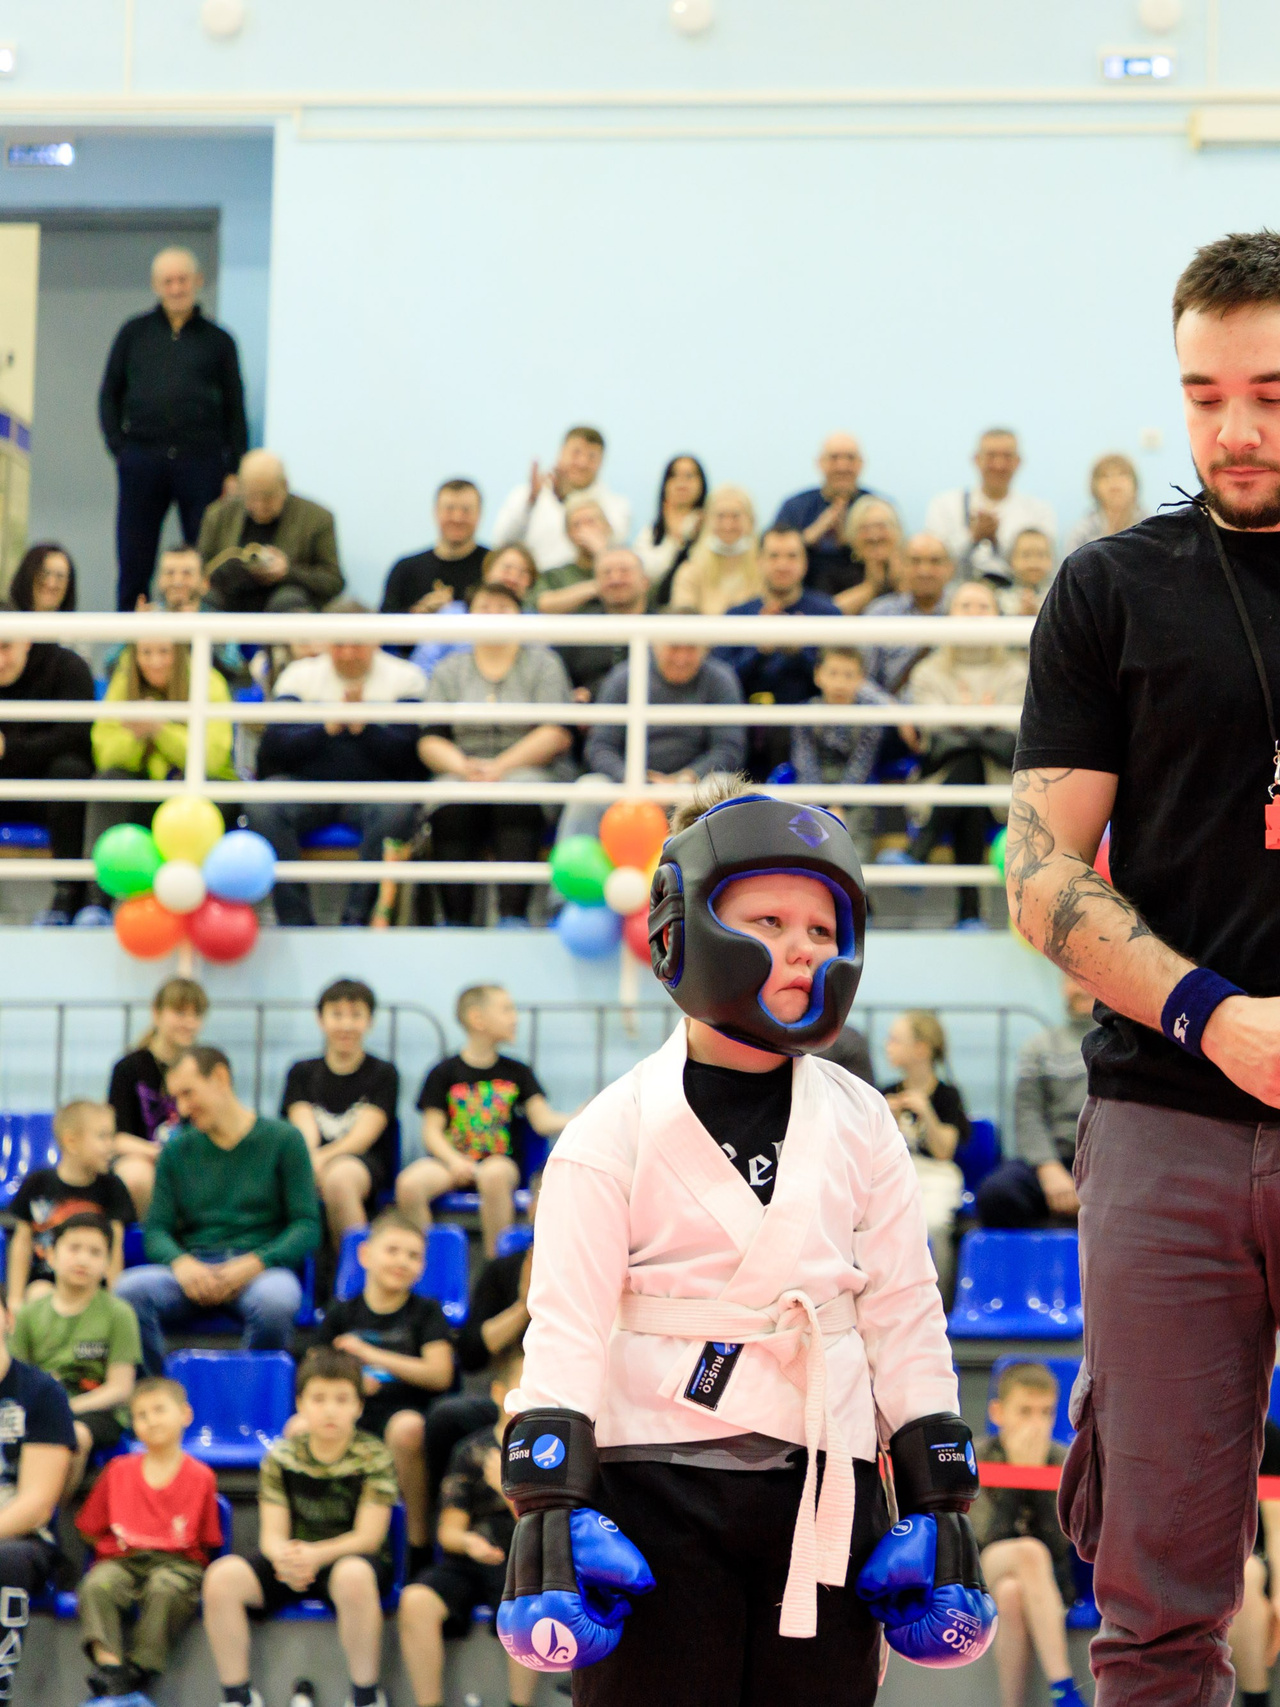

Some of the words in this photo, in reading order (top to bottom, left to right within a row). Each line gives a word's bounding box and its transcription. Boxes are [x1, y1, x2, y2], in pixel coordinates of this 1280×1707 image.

[702, 1355, 725, 1394] RUSCO
[938, 1452, 966, 1463] RUSCO
[952, 1620, 977, 1637] SPORT
[942, 1628, 983, 1658] RUSCO
